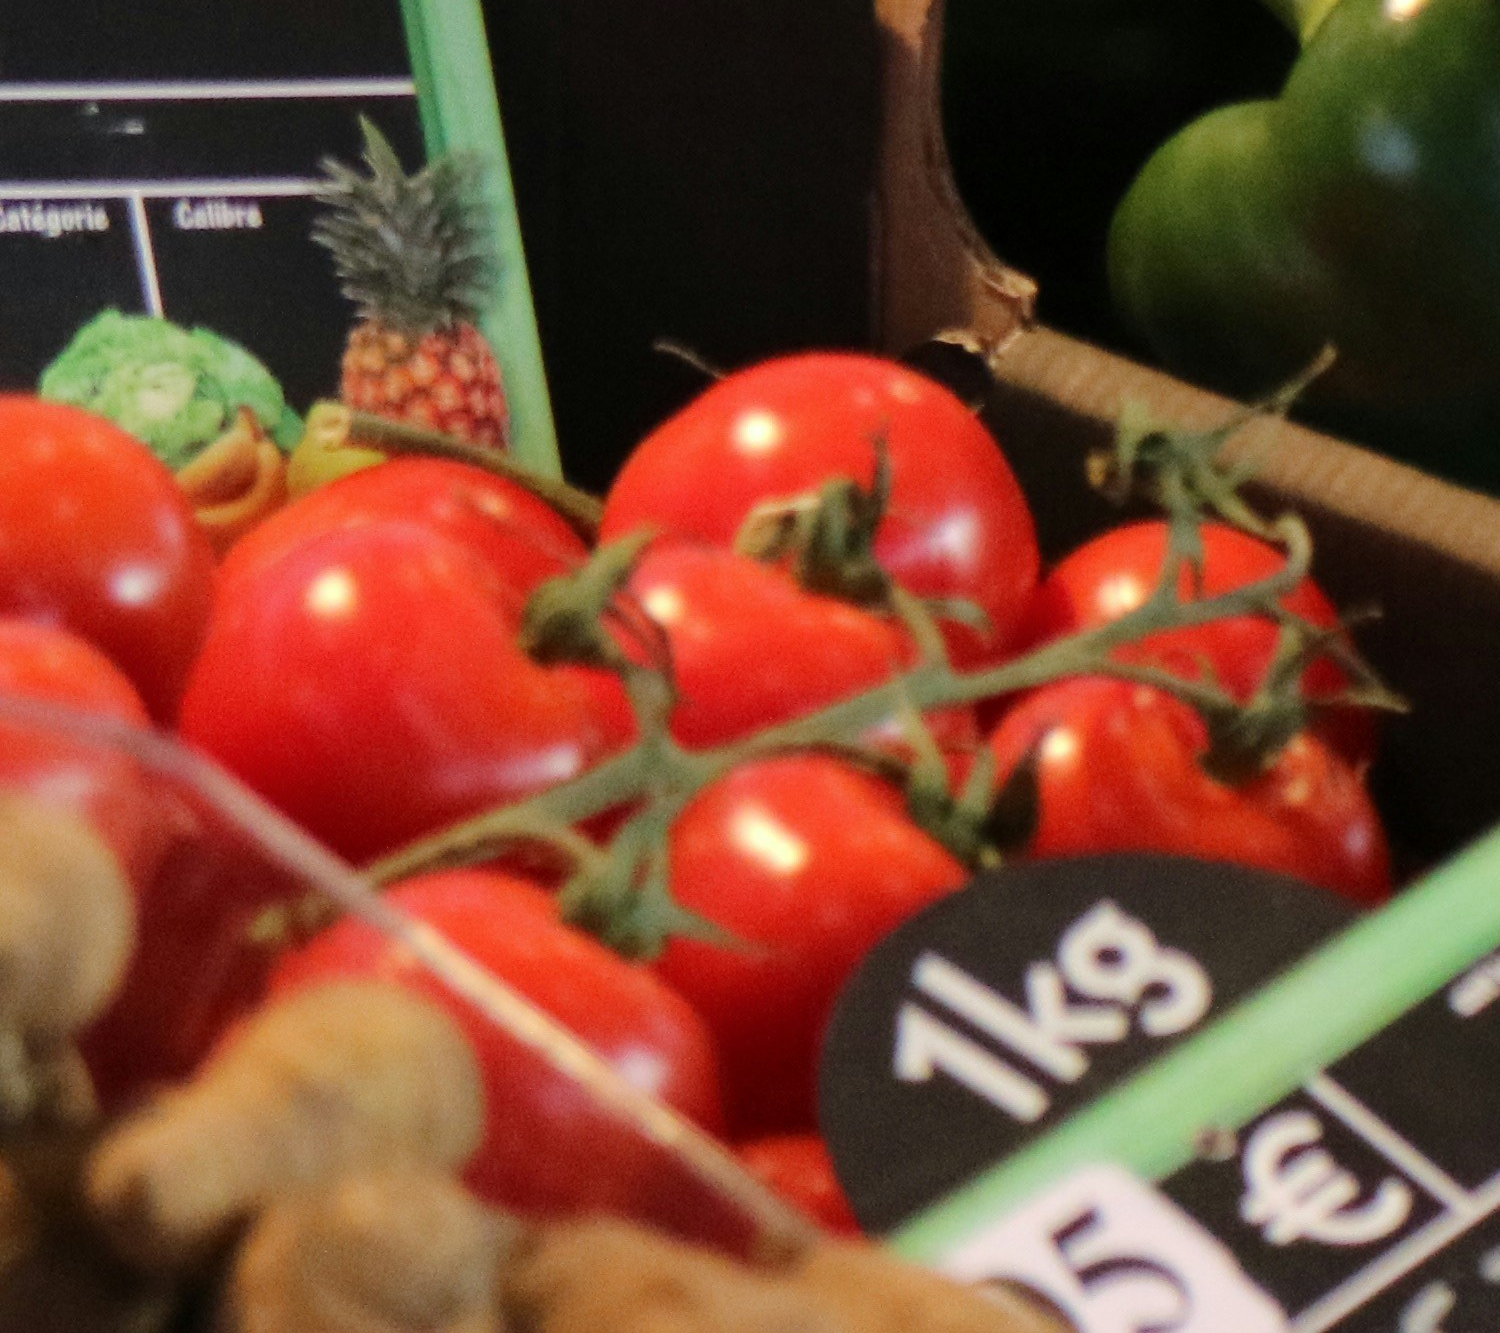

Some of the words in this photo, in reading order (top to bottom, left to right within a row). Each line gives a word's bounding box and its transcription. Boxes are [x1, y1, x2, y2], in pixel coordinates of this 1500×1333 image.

[0, 198, 110, 239] atégorie
[893, 898, 1214, 1122] 1kg
[1239, 1108, 1414, 1248] €
